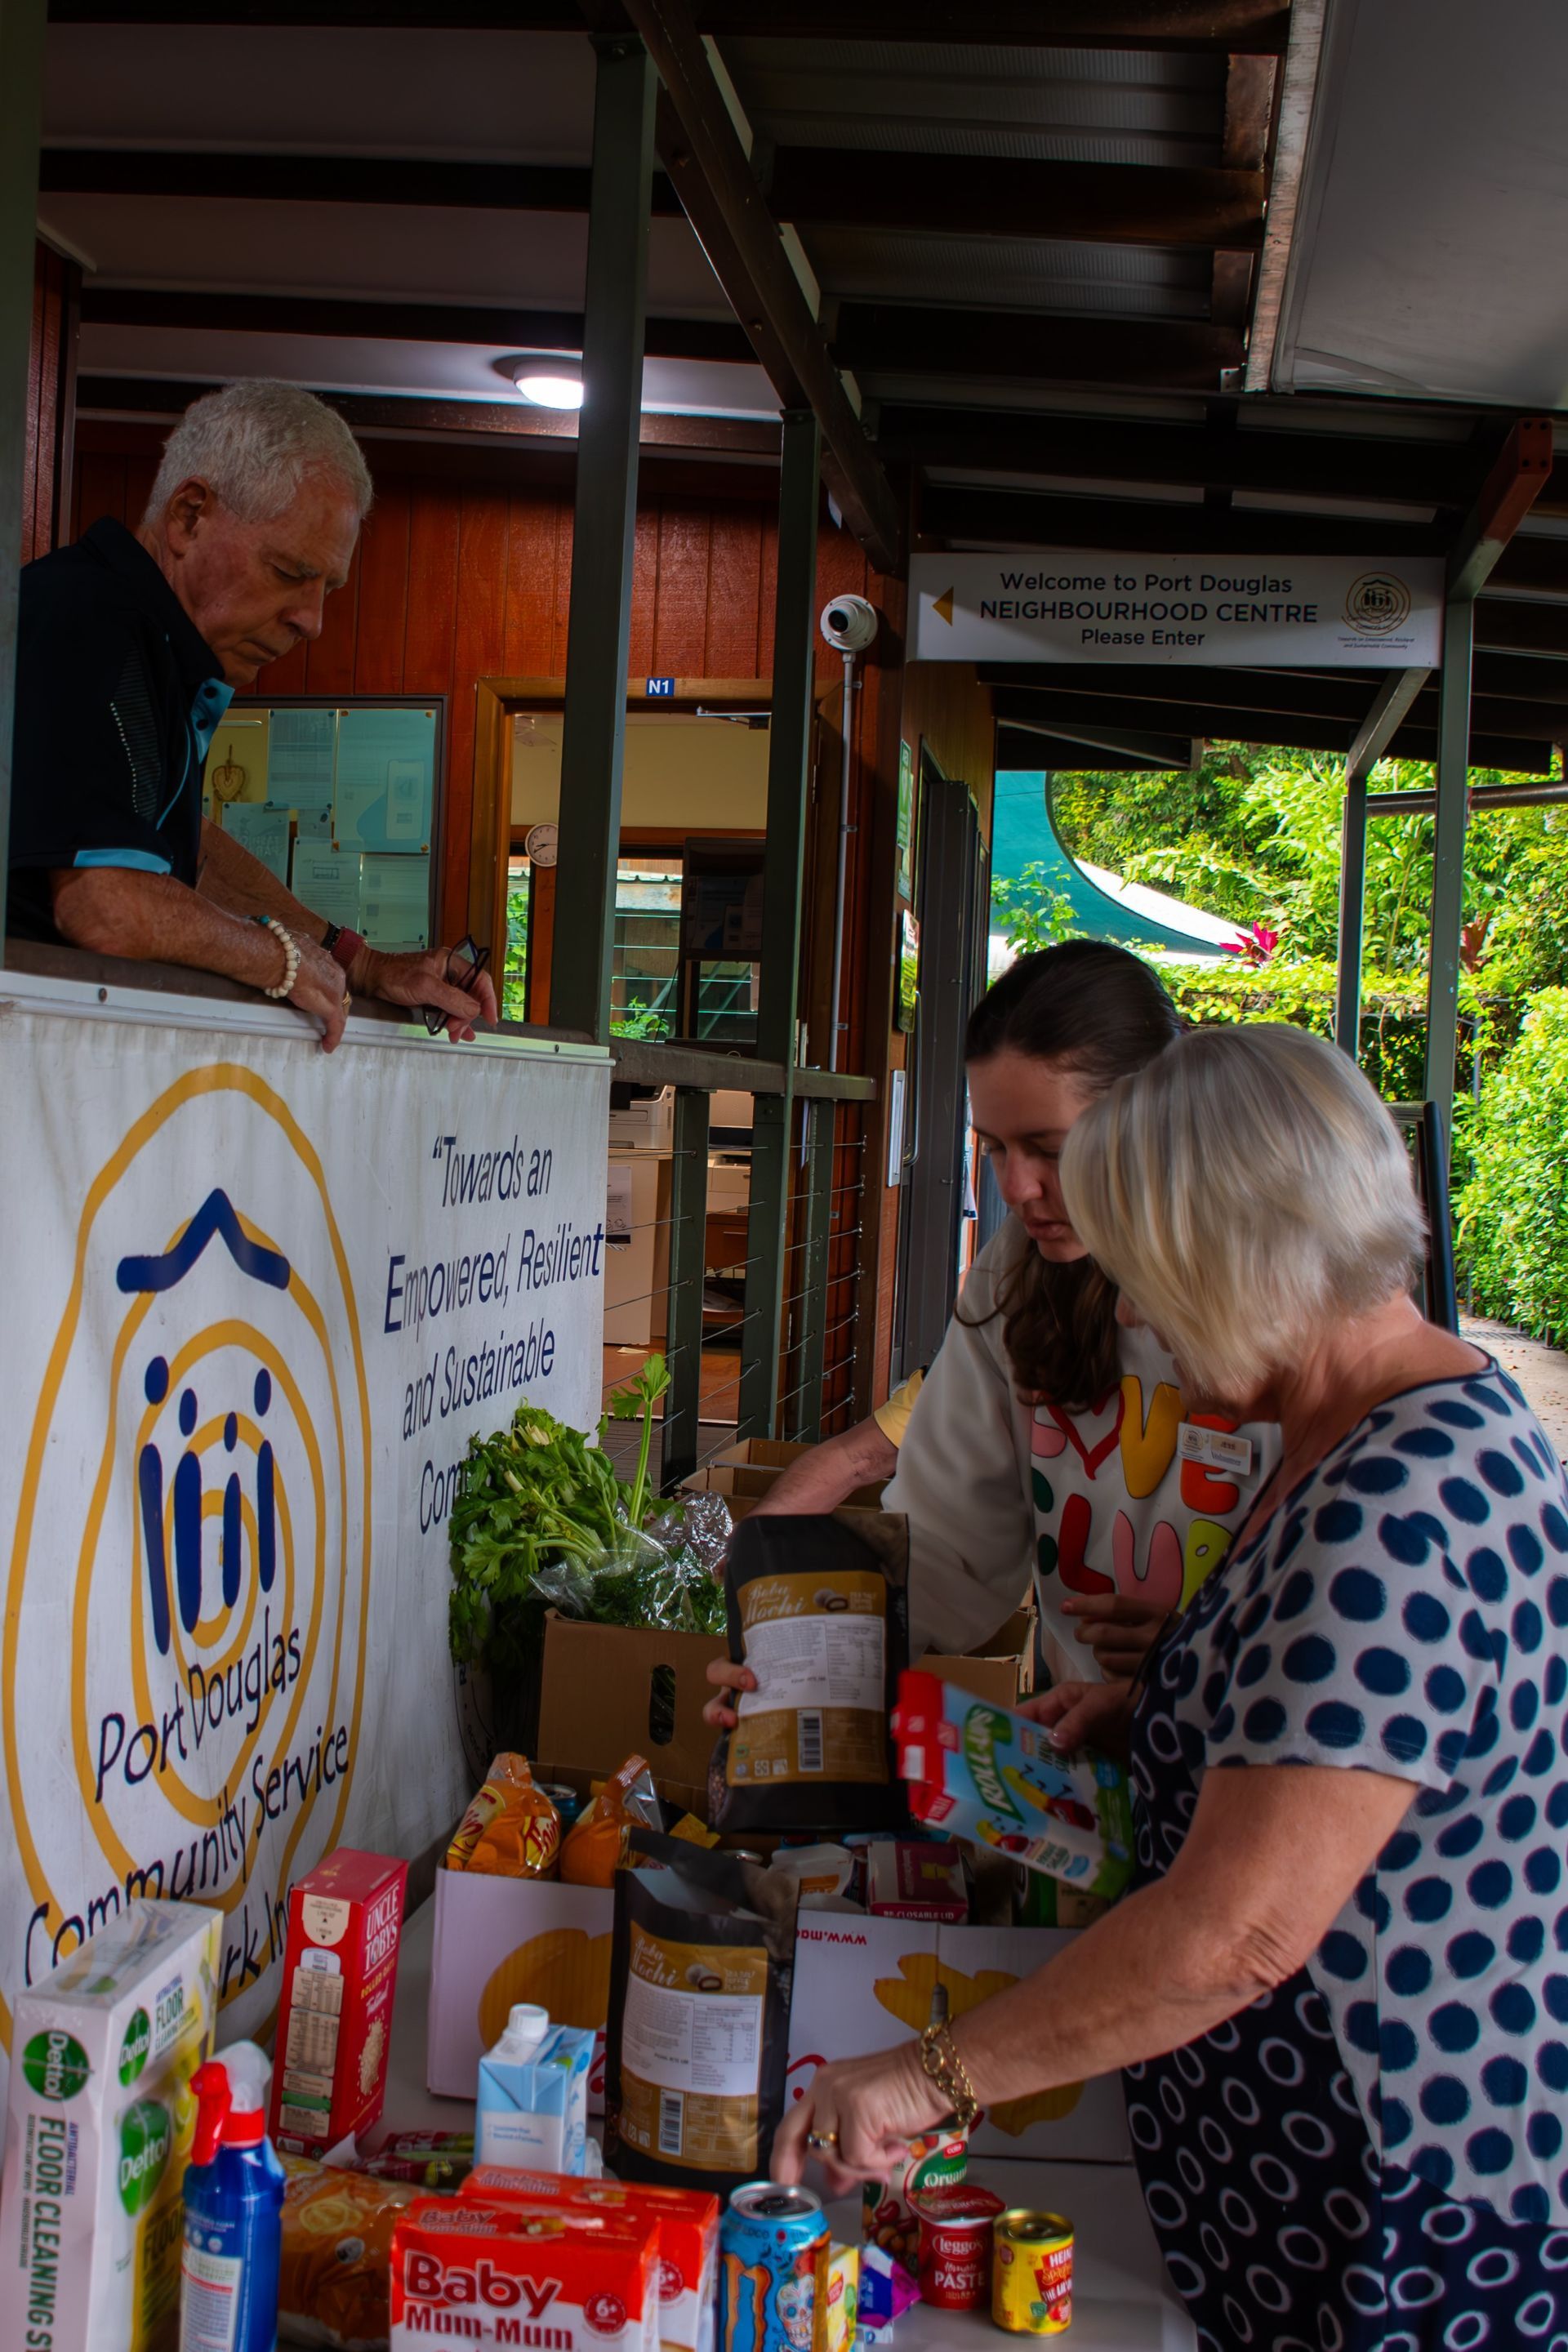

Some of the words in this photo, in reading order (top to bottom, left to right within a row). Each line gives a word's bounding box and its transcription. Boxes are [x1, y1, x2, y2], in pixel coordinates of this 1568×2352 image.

[1000, 572, 1107, 592] Welcome
[1113, 573, 1137, 592] to
[1144, 573, 1193, 593] Port
[1200, 574, 1292, 596] Douglas
[980, 600, 1208, 622] NEIGHBOURHOOD
[1216, 603, 1318, 624] CENTRE
[1081, 629, 1146, 644] Please
[1152, 630, 1205, 645] Enter
[648, 679, 670, 694] N1
[528, 1147, 553, 1197] an
[384, 1232, 511, 1341] Empowered,
[517, 1223, 604, 1293] Resilient
[403, 1352, 438, 1442] and
[439, 1317, 555, 1419] Sustainable
[95, 1680, 188, 1803] Port
[188, 1605, 301, 1751] Douglas
[252, 1725, 350, 1838] Service
[366, 1885, 400, 1941] UNCLE
[940, 1912, 955, 1921] LID
[364, 1916, 399, 1971] TOBYS
[156, 1986, 184, 2034] FLOOR
[43, 2031, 69, 2101] Dettol
[119, 2027, 150, 2063] Dettol
[35, 2117, 65, 2196] FLOOR
[121, 2123, 171, 2192] Dettol
[28, 2201, 61, 2327] CLEANING
[404, 2248, 563, 2319] Baby
[934, 2270, 986, 2290] PASTE
[407, 2305, 573, 2350] Mum-Mum
